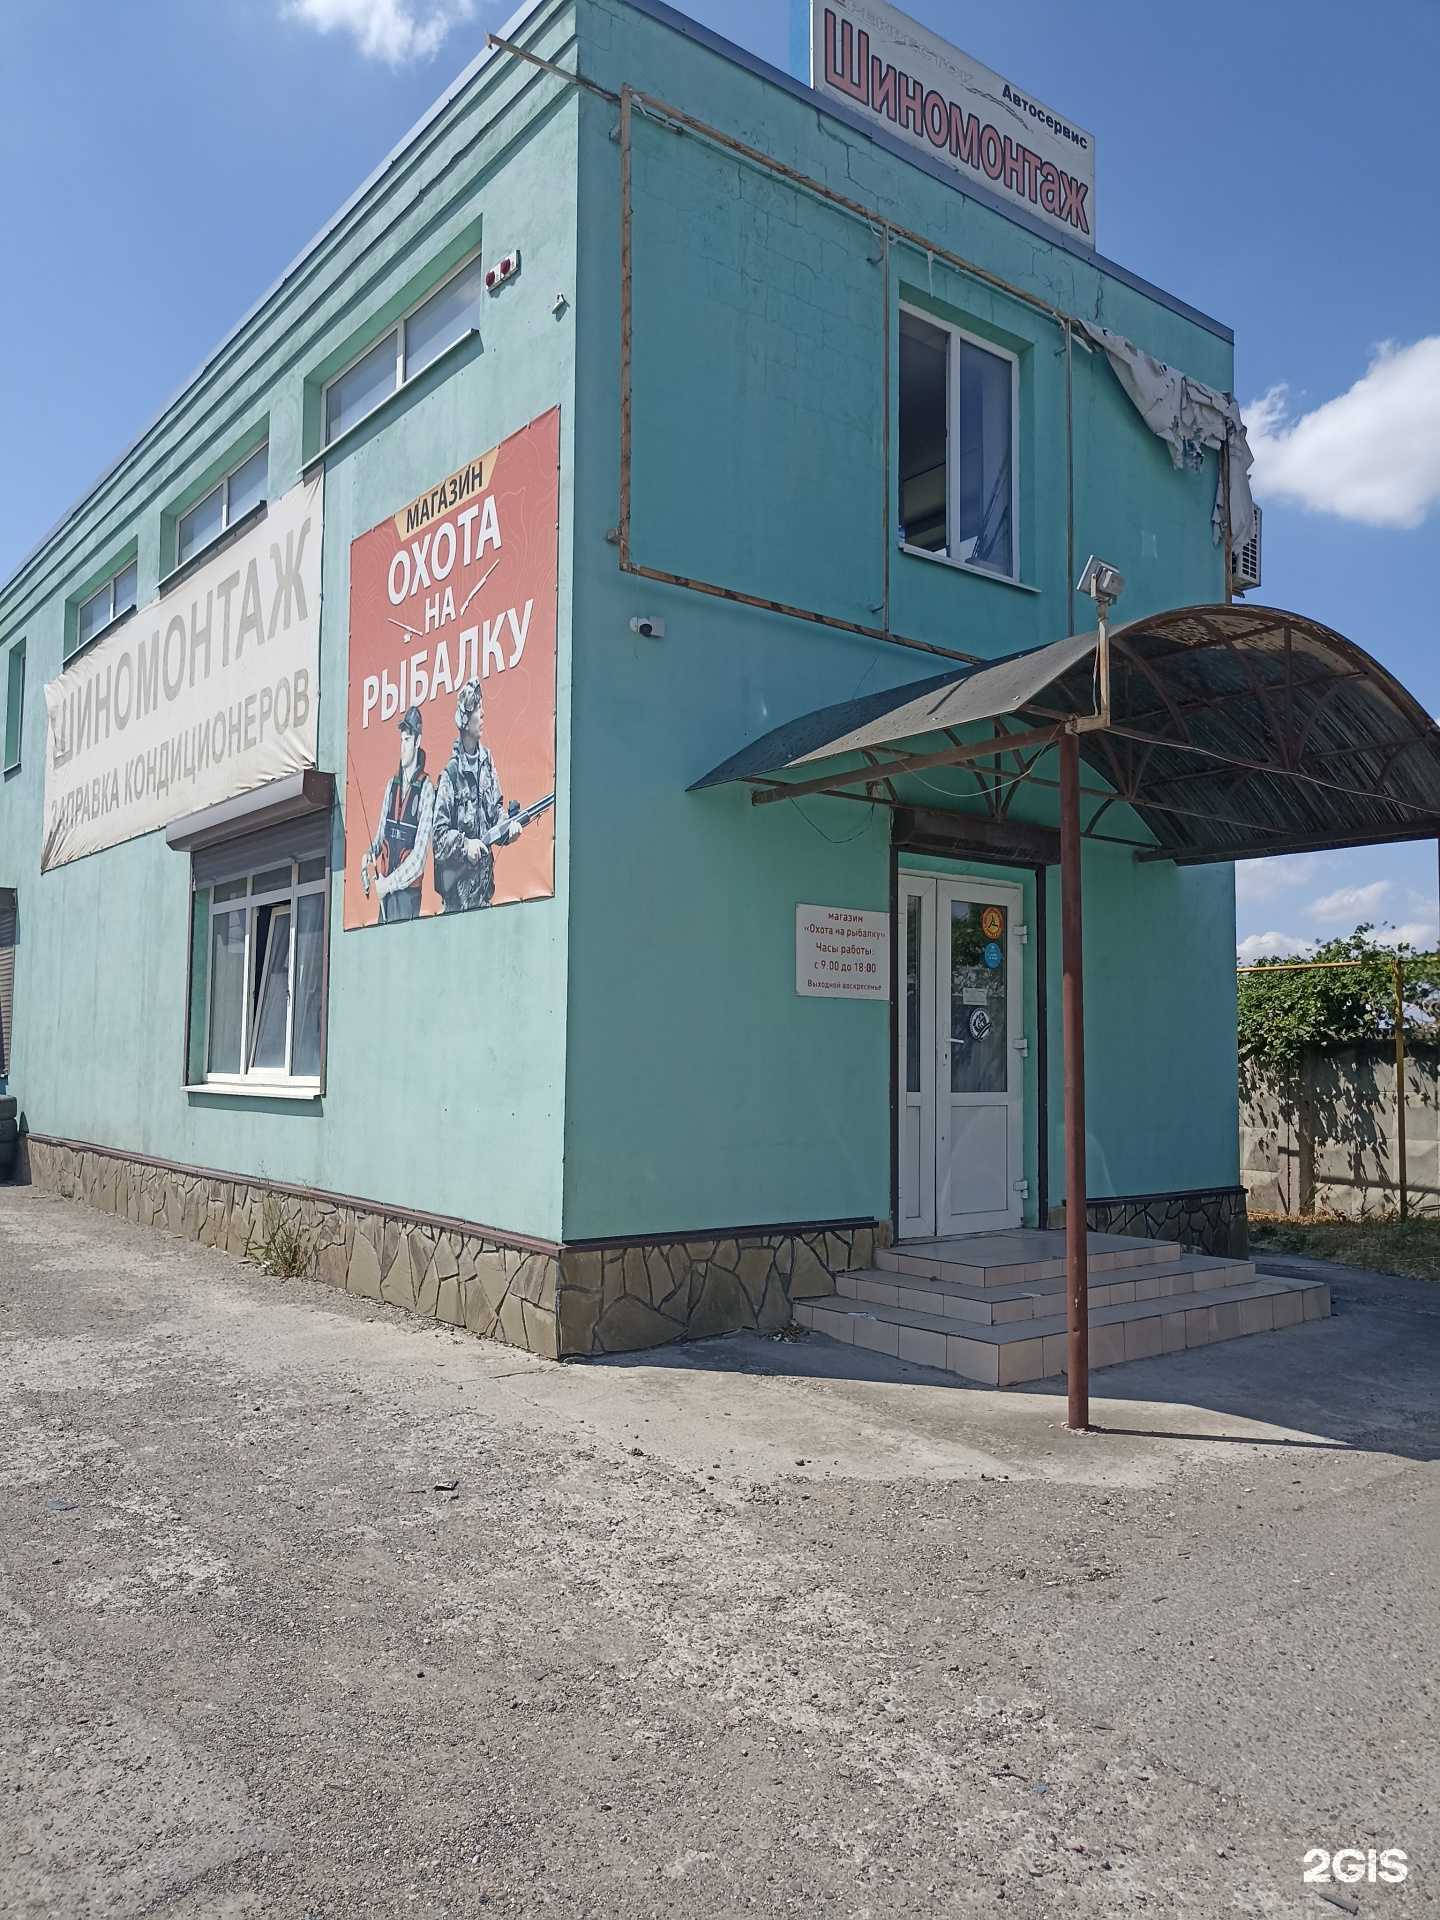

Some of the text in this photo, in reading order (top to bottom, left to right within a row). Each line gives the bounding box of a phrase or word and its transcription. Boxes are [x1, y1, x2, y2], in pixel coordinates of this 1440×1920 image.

[824, 8, 1090, 235] Шиномонтаж
[1001, 84, 1088, 150] Автосервис
[406, 462, 484, 534] МАГАЗИН
[388, 495, 503, 607] ОХОТА
[50, 517, 312, 770] ШИНОМОНТАЖ
[424, 586, 457, 634] НА
[362, 598, 534, 730] РЫБАЛКУ
[124, 667, 310, 805] КОНДИЦИОНЕРОВ
[828, 912, 864, 923] магазин
[841, 963, 852, 973] до
